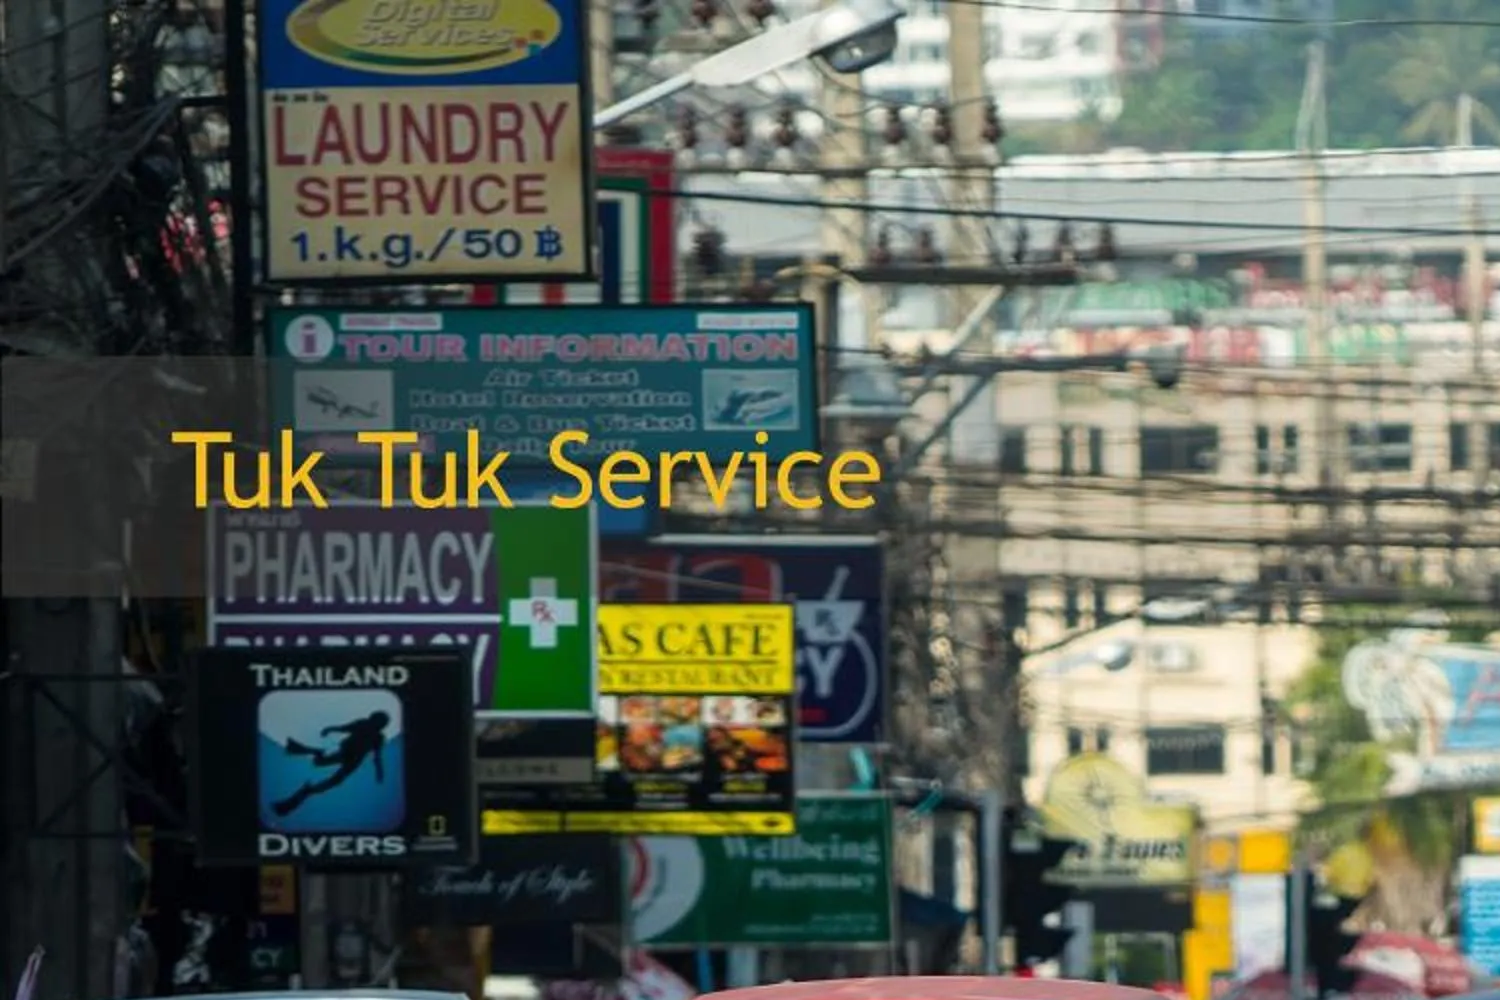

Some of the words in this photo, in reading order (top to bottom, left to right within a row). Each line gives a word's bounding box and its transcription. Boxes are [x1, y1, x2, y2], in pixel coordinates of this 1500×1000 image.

[274, 101, 569, 166] LAUNDRY
[295, 173, 548, 219] SERVICE
[337, 333, 466, 362] TOUR
[480, 332, 799, 361] INFORMATION
[224, 531, 494, 605] PHARMACY
[655, 622, 778, 657] CAFE
[248, 663, 411, 687] THAILAND
[258, 833, 407, 857] DIVERS
[722, 835, 880, 865] Wellbeing
